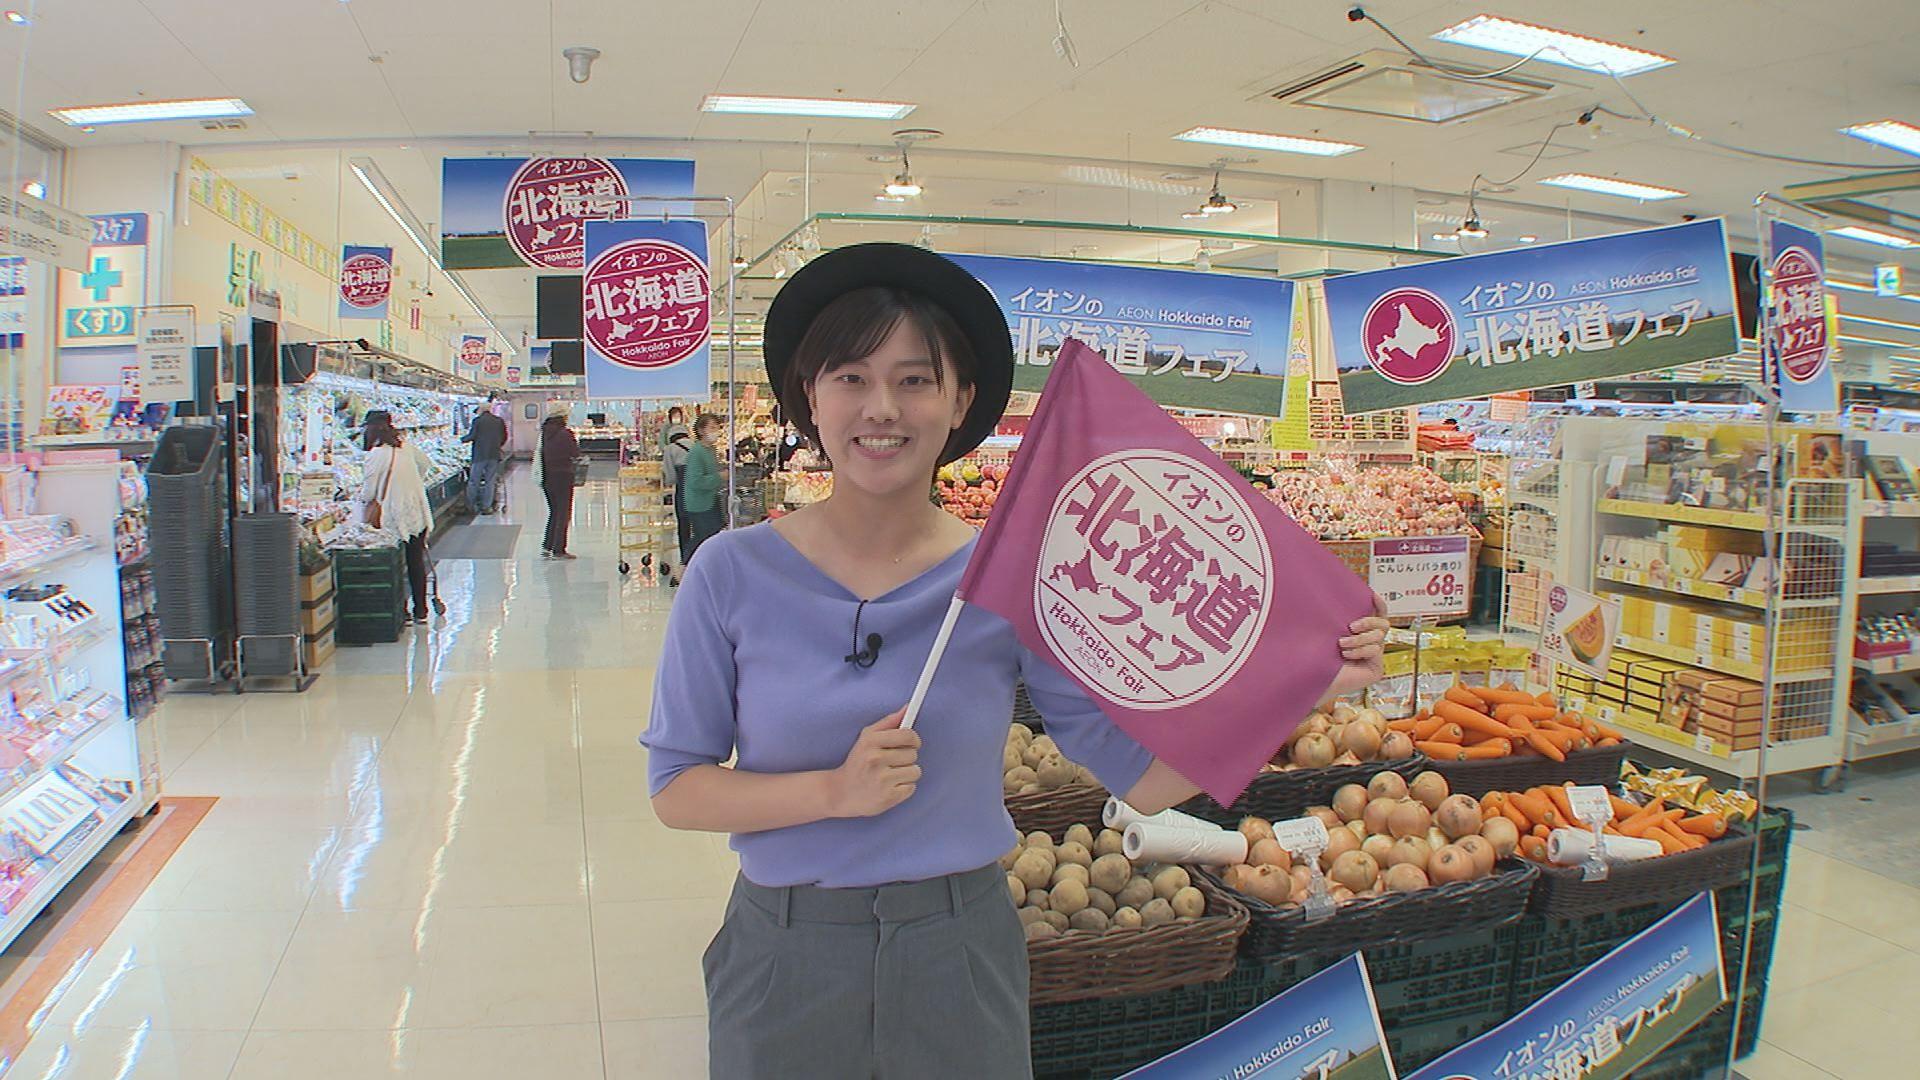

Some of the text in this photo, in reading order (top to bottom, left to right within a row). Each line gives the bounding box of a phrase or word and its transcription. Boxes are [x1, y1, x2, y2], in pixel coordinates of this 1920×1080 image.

[537, 160, 588, 176] イオンの
[543, 249, 584, 262] Hokkaid
[611, 252, 668, 270] イオンの
[585, 267, 707, 320] 北海道
[1010, 286, 1253, 330] イオンの AEON Hokkaido Fair
[1460, 265, 1698, 312] イオンの AEON Hokkaido Fair
[74, 308, 126, 334] くすり
[622, 337, 691, 357] Hokkaido Fair
[637, 307, 702, 337] フェア
[1464, 299, 1700, 369] 北海道フェア
[1162, 472, 1246, 544] イオンの
[1064, 472, 1263, 655] 北海道
[1049, 601, 1146, 694] Hokkaido Fair
[1097, 586, 1206, 672] フェア
[1493, 1019, 1577, 1077] イオンの
[1616, 959, 1669, 999] Hokkaido
[1512, 972, 1700, 1080] 海道フェア
[1233, 1016, 1332, 1080] Hokkaido Fair
